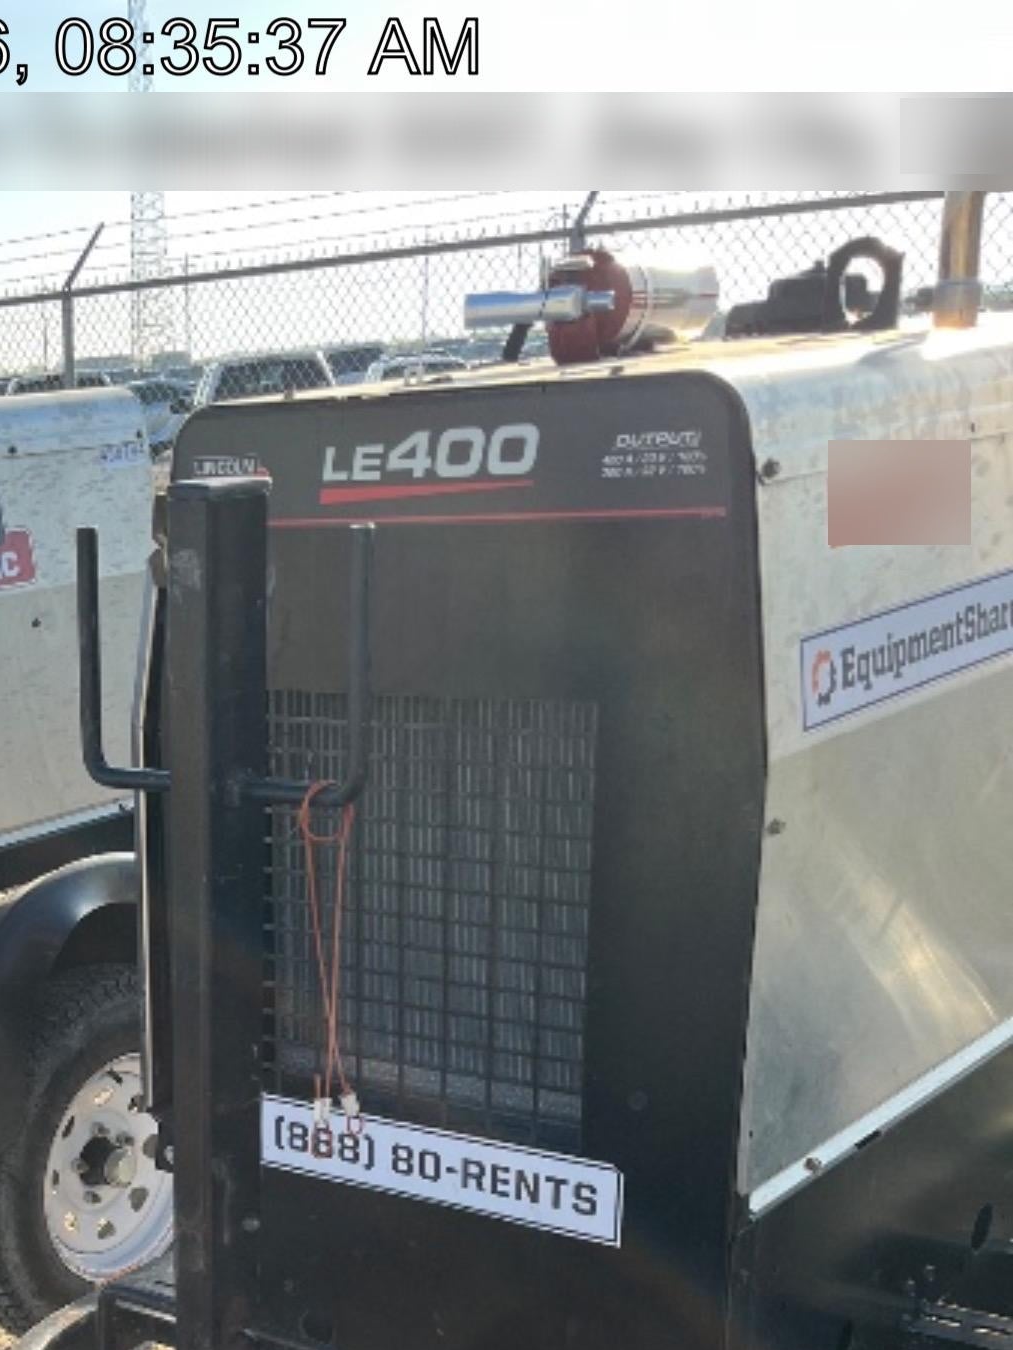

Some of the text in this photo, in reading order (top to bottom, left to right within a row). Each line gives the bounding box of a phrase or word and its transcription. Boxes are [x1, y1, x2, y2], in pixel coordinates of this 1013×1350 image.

[323, 423, 540, 481] LE400
[840, 598, 1013, 691] EquipmentShar
[274, 1115, 599, 1217] (888) 80-RENTS
